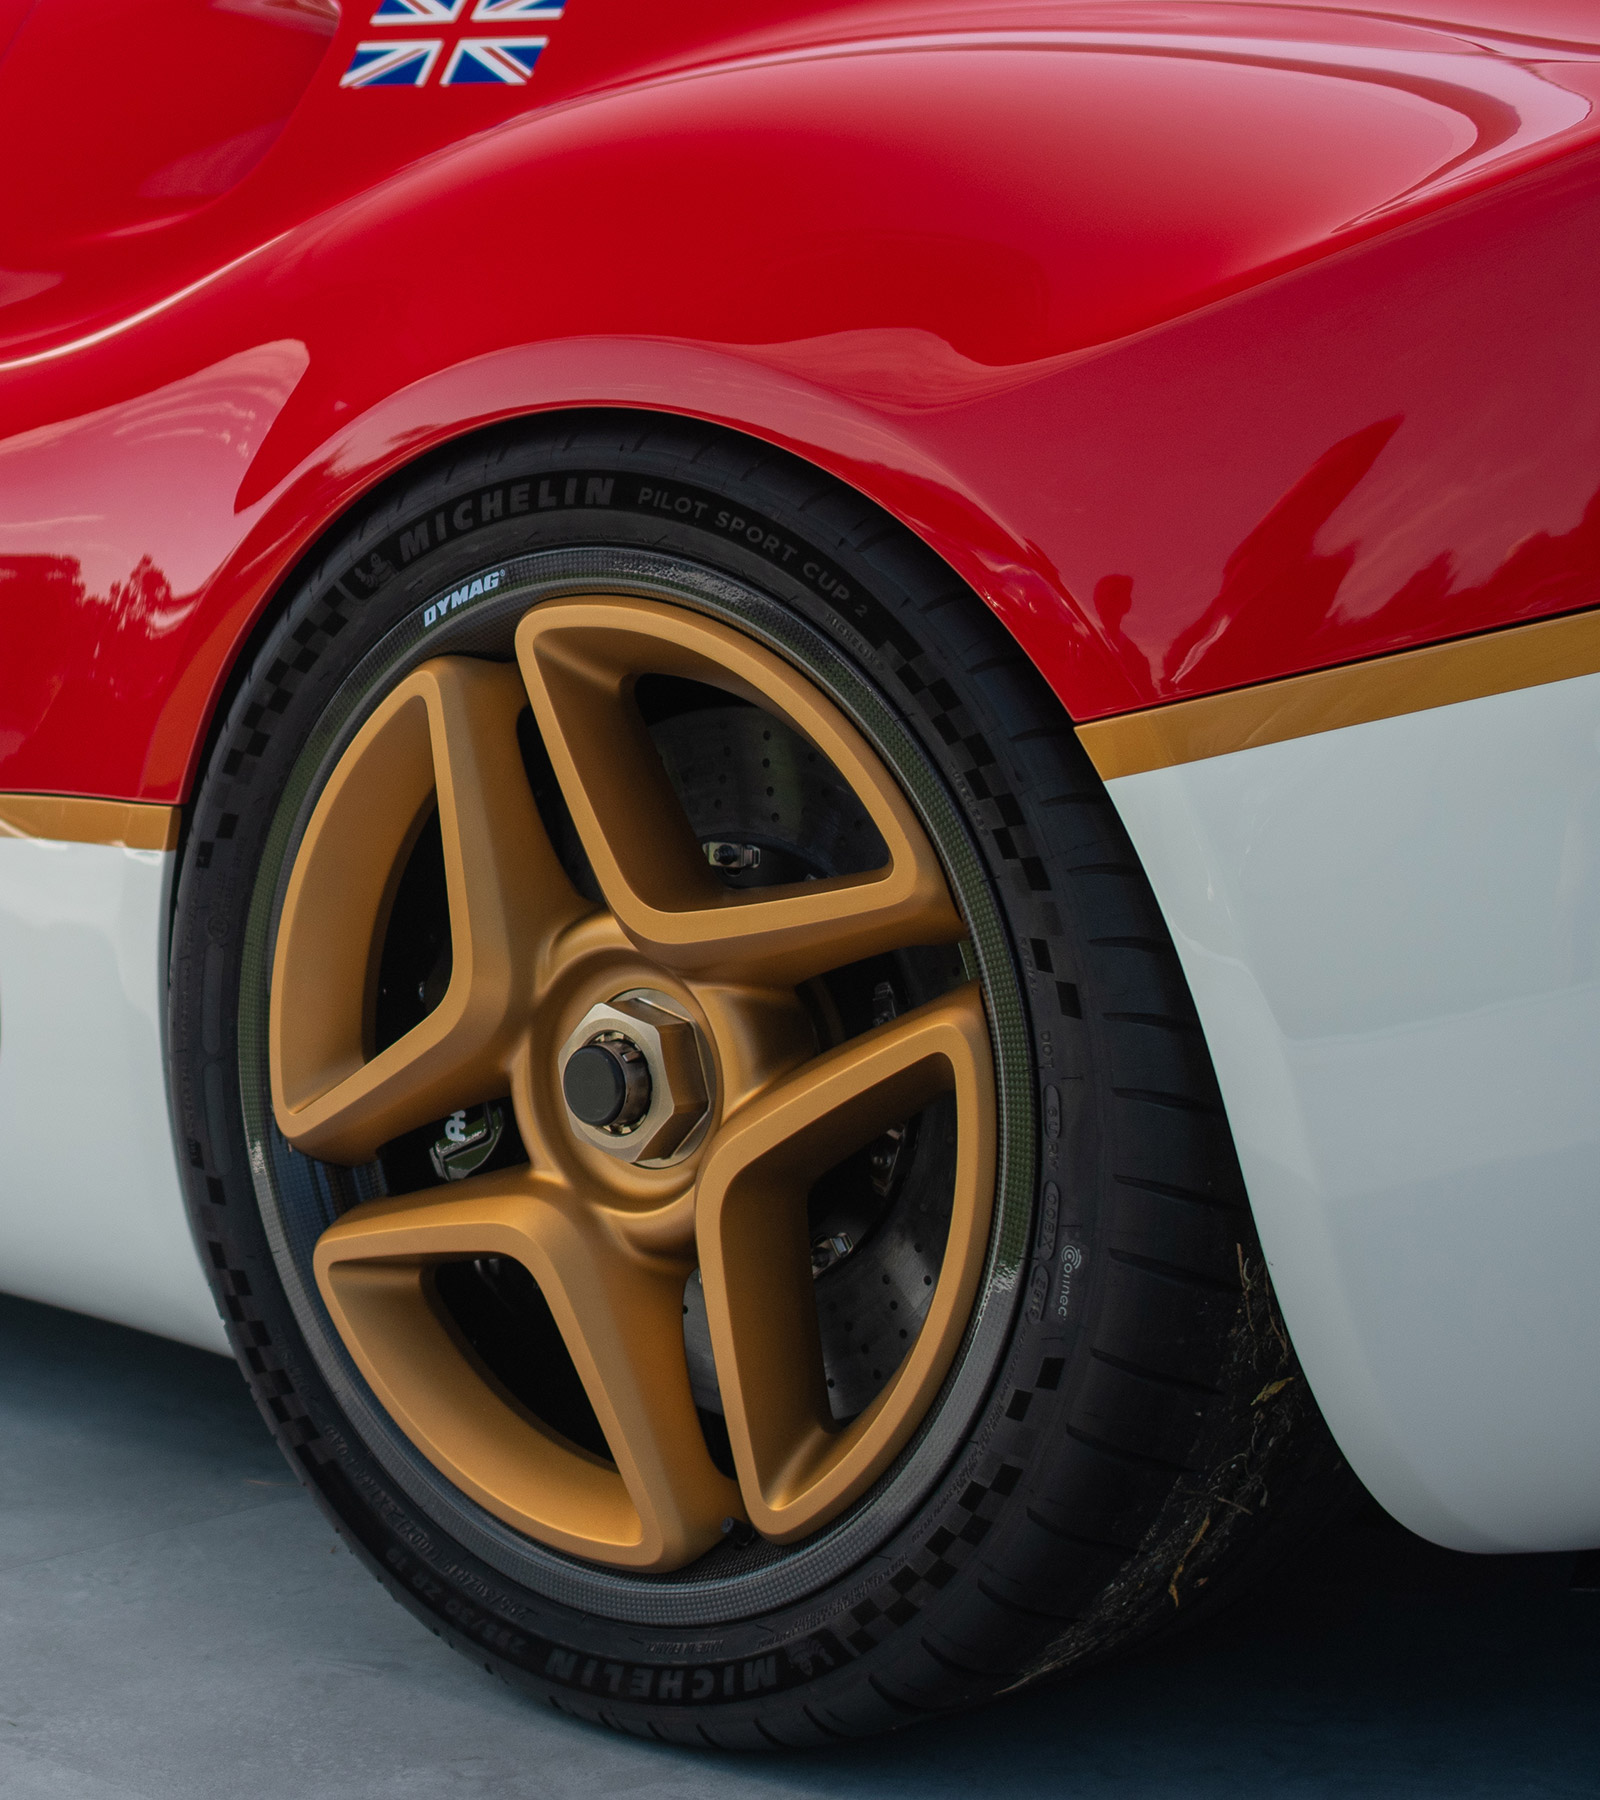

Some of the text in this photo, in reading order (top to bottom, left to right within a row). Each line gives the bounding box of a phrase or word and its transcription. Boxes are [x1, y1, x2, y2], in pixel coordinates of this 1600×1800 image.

[399, 476, 868, 619] MICHELIN PILOT SPORT CUP 2
[423, 570, 501, 628] DYMAG
[1058, 1243, 1083, 1317] Connec
[546, 1649, 777, 1699] MICHELIN
